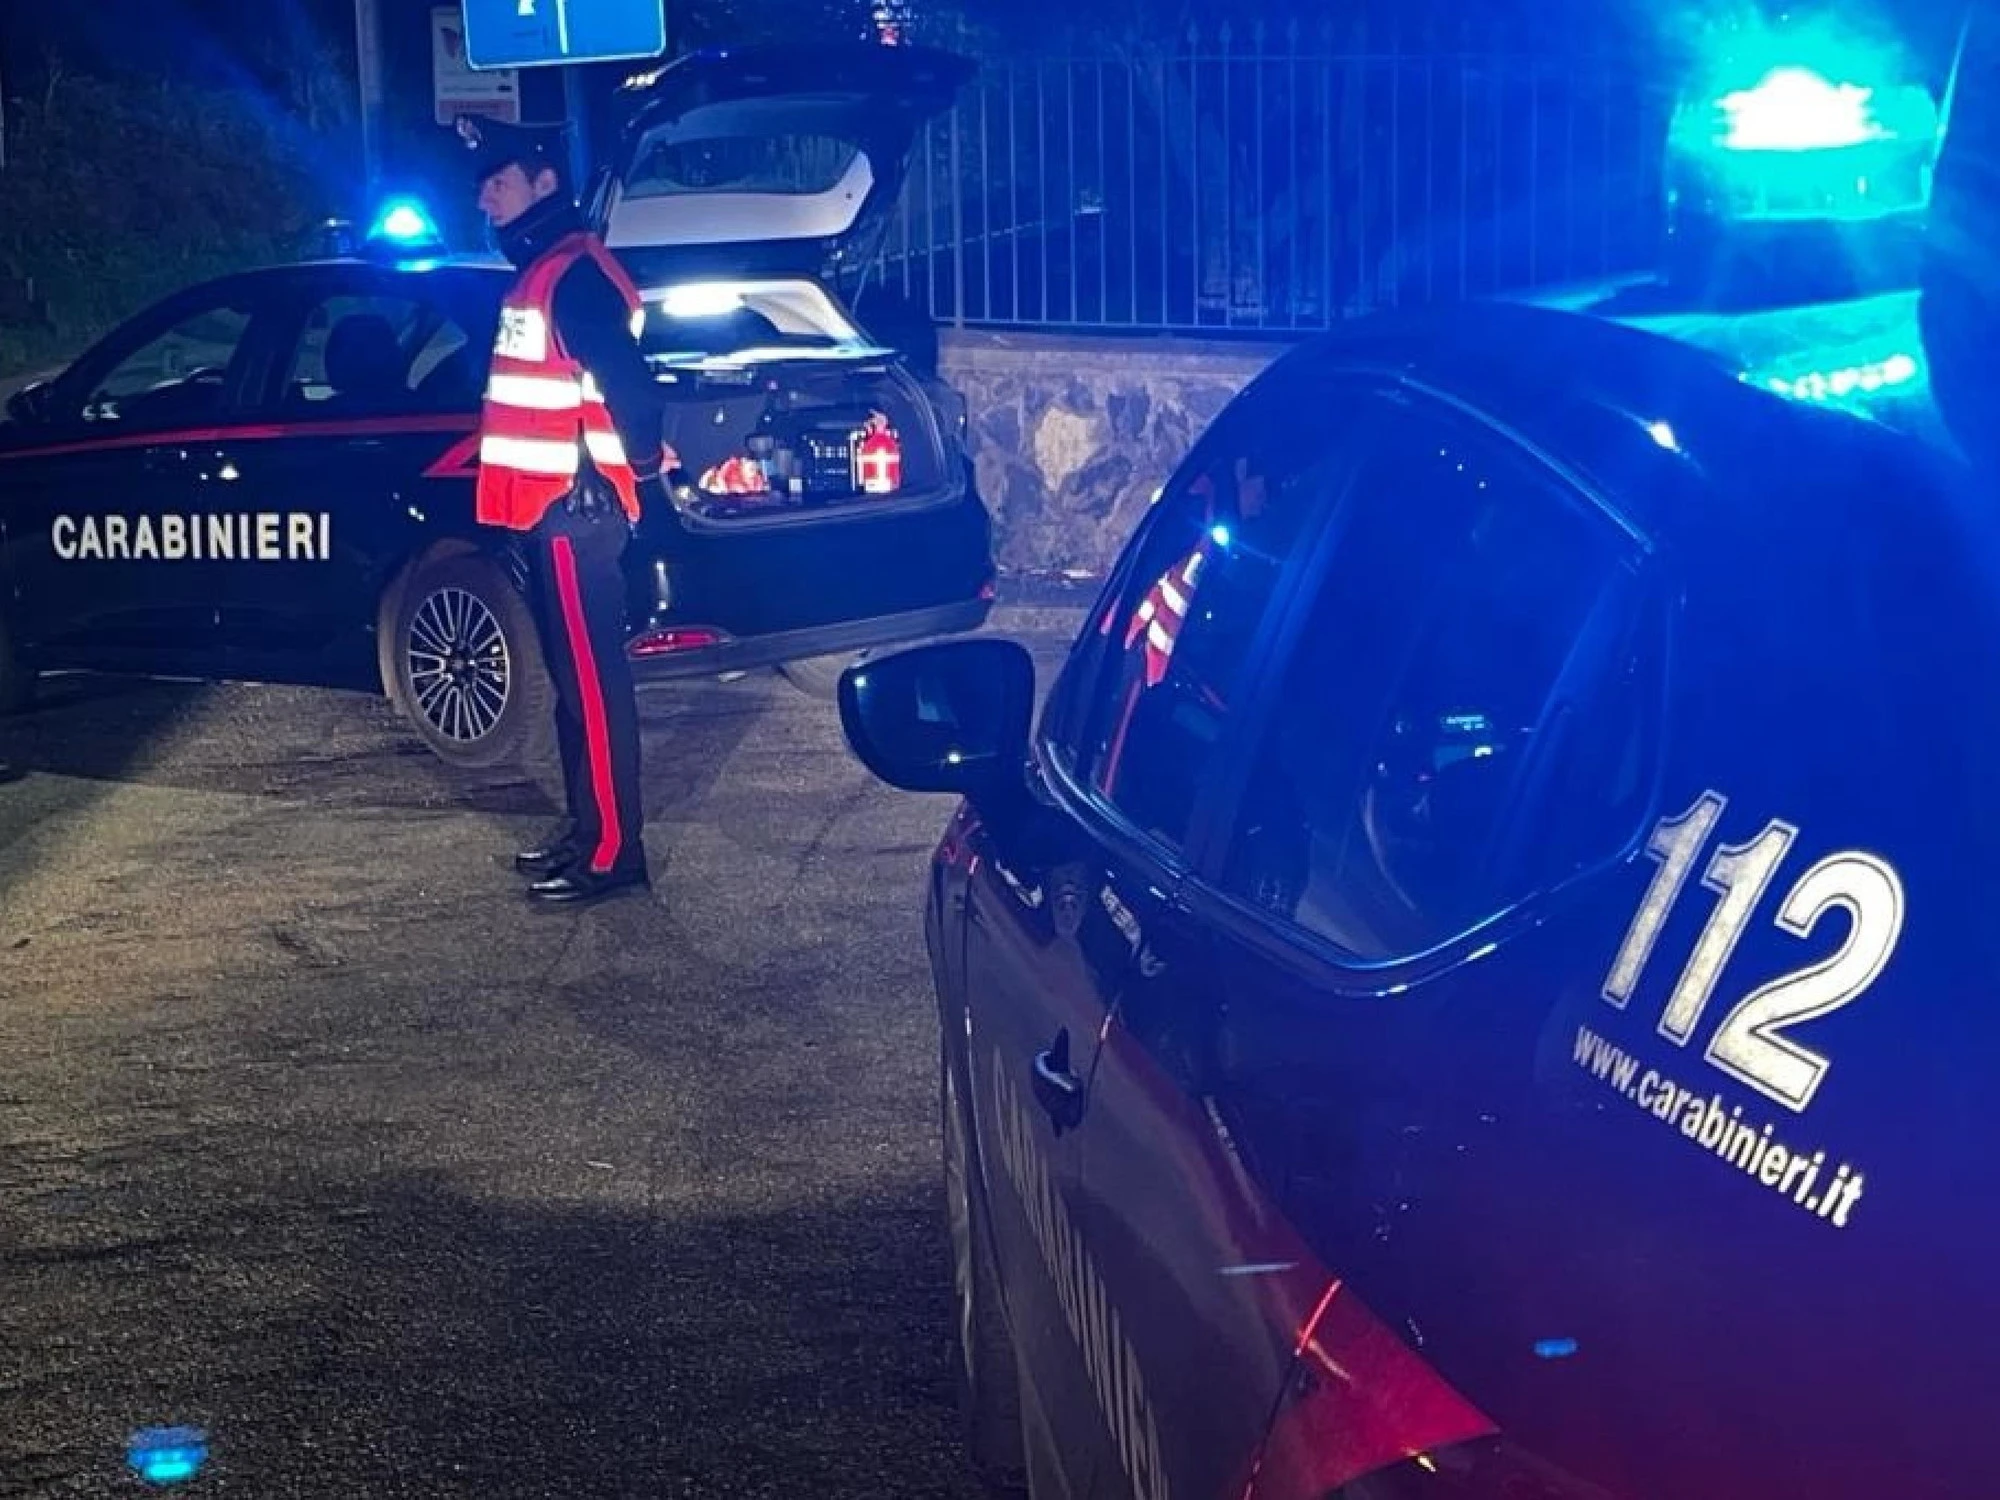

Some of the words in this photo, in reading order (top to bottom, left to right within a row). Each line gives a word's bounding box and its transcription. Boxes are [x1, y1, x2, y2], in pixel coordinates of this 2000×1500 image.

[52, 513, 330, 560] CARABINIERI
[1602, 789, 1905, 1113] 112
[1573, 1025, 1863, 1228] www.carabinieri.it
